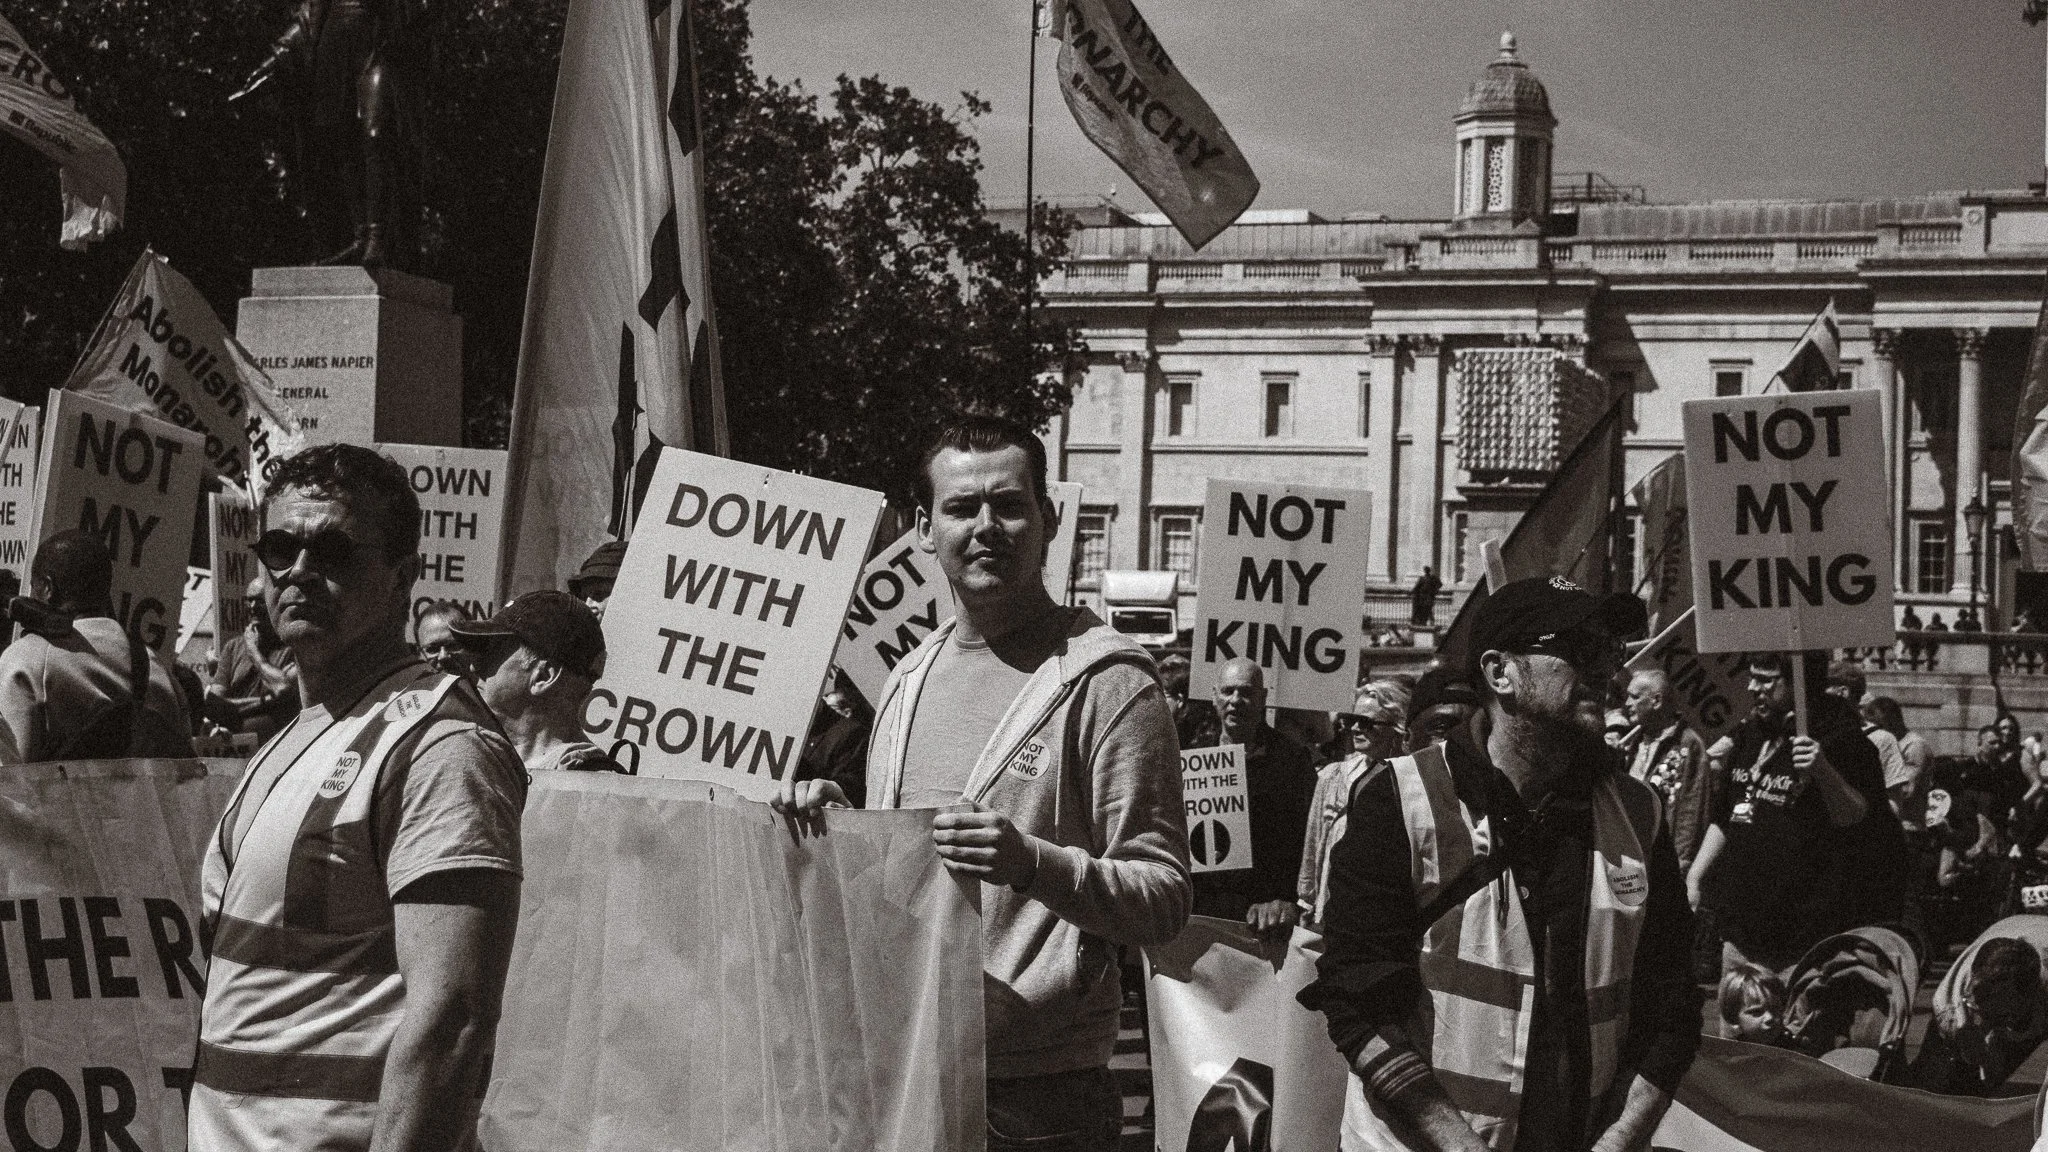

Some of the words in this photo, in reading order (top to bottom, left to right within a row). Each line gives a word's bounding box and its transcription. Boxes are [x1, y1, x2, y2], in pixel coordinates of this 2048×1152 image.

[129, 294, 244, 418] Abolish
[291, 357, 328, 369] JAMES
[331, 356, 374, 369] NAPIER
[74, 411, 184, 494] NOT
[1712, 405, 1851, 464] NOT
[78, 497, 161, 568] MY
[421, 509, 478, 540] ITH
[665, 483, 846, 561] DOWN
[1228, 491, 1346, 544] NOT
[1735, 480, 1840, 535] MY
[663, 554, 805, 628] WITH
[843, 546, 927, 641] NOT
[1235, 556, 1328, 606] MY
[1707, 553, 1877, 610] KING
[657, 627, 767, 696] THE
[874, 598, 940, 672] MY
[1205, 618, 1346, 674] KING
[336, 756, 359, 768] NOT
[582, 688, 796, 783] CROWN
[1019, 752, 1038, 764] MY
[1024, 742, 1045, 755] NOT
[320, 780, 346, 791] KING
[332, 768, 349, 778] MY
[1010, 760, 1038, 777] KING
[1183, 777, 1208, 790] ITH
[1211, 774, 1238, 787] THE
